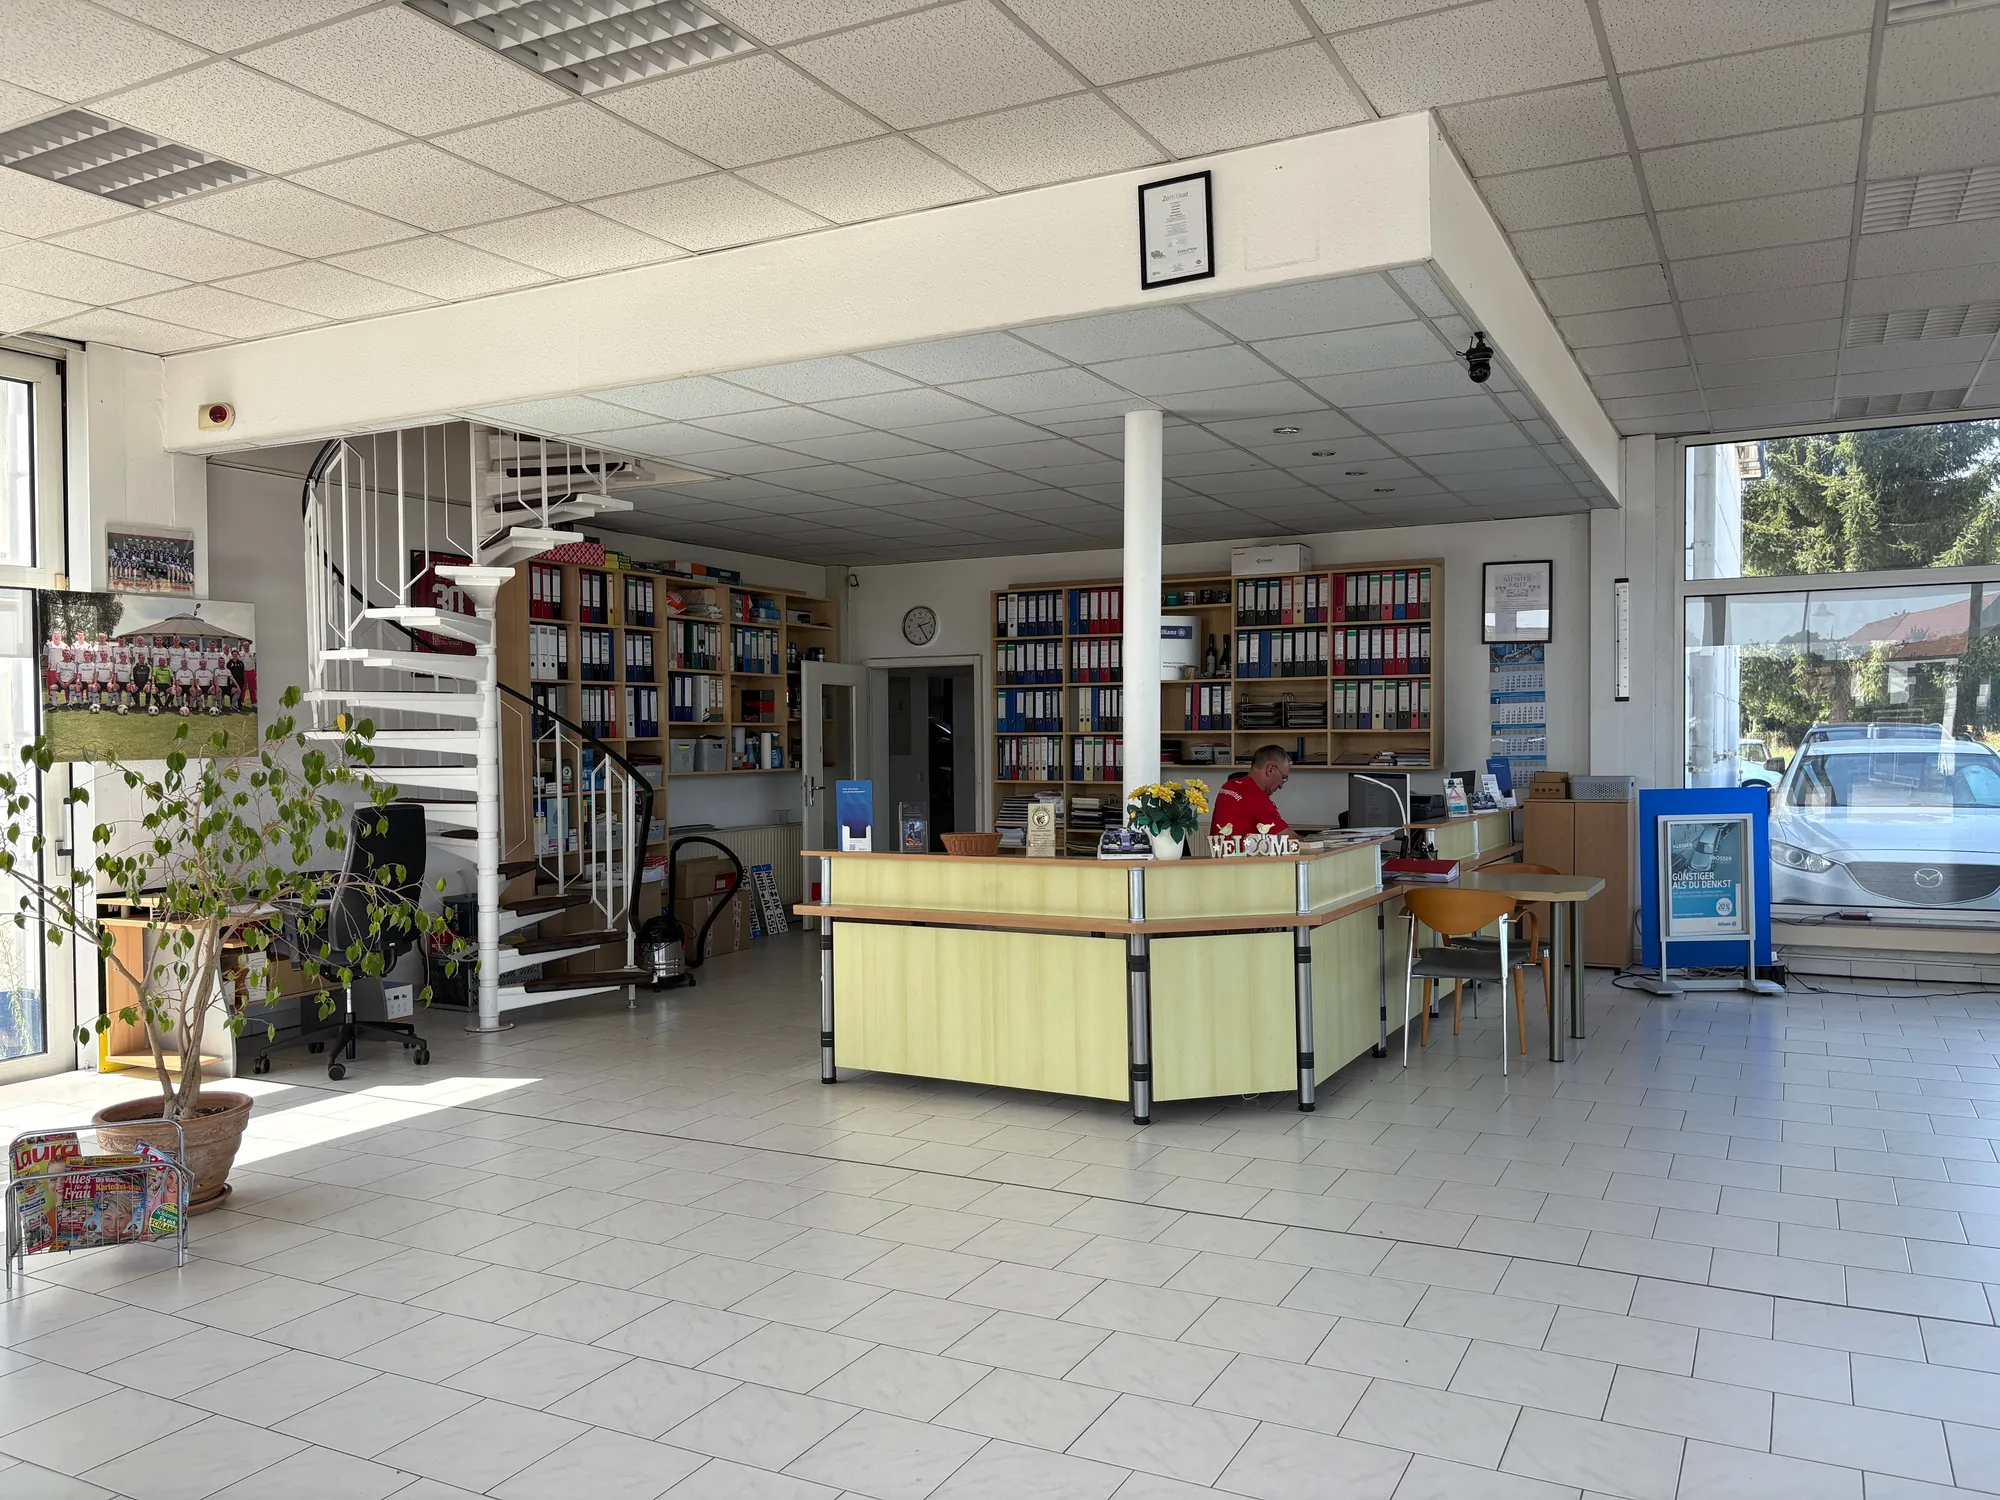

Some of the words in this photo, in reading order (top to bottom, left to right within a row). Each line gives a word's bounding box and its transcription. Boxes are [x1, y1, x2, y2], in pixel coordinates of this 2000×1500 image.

[1162, 191, 1188, 202] Zertifikat
[432, 583, 464, 613] 30
[1672, 871, 1715, 881] GÜNSTIGER
[1672, 881, 1687, 889] ALS
[1688, 881, 1700, 889] DU
[1701, 880, 1732, 889] DENKST
[766, 914, 777, 934] 555
[776, 912, 786, 932] 555
[14, 1144, 79, 1171] Laura
[65, 1174, 91, 1184] Alles
[64, 1188, 91, 1200] Frau
